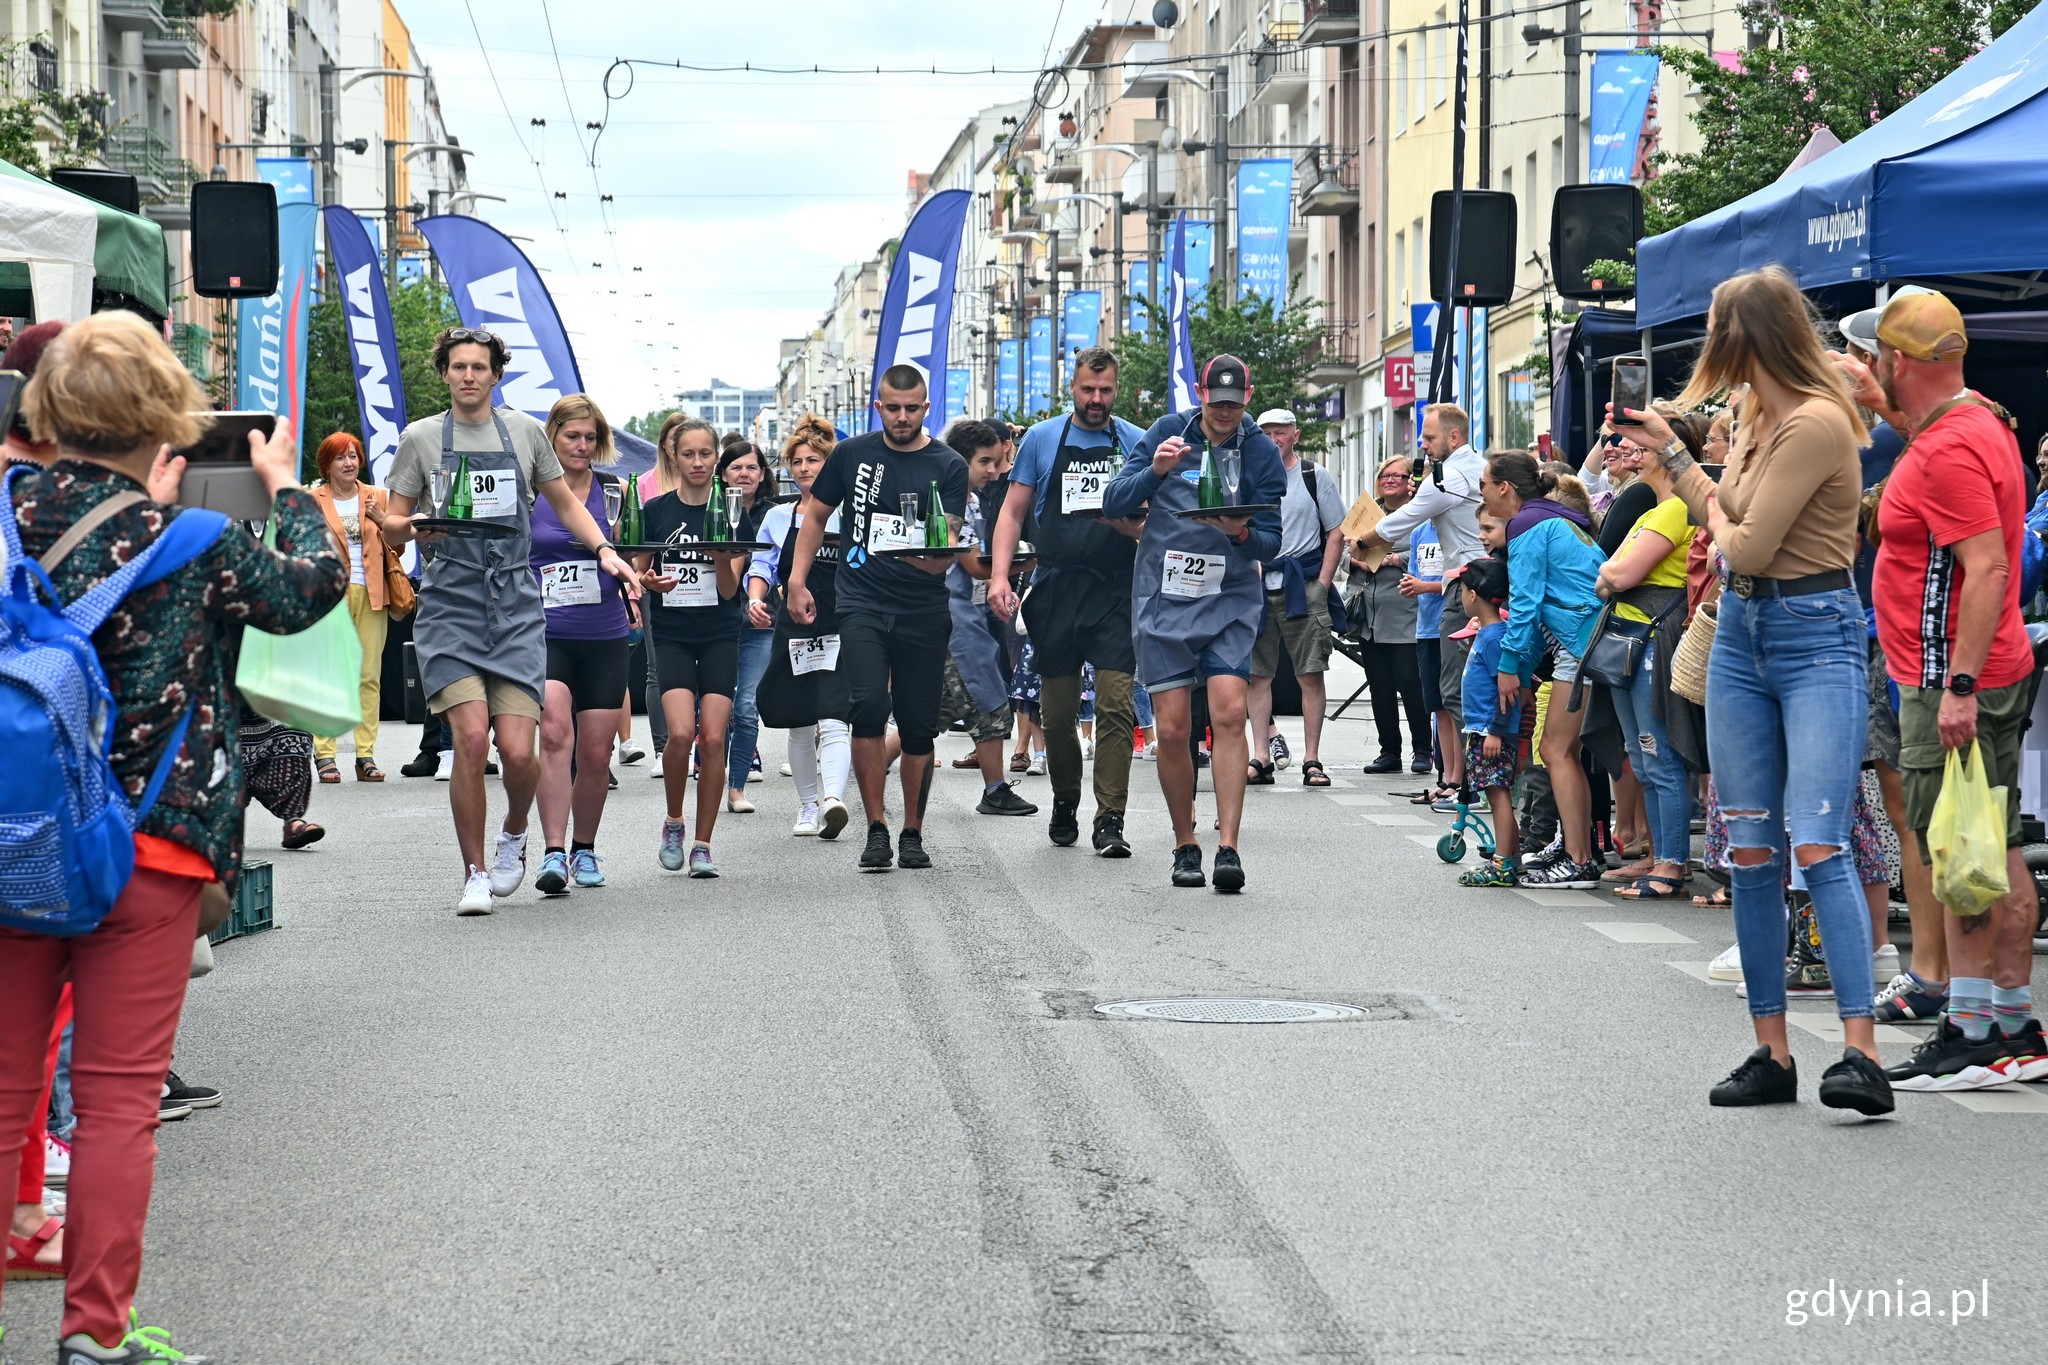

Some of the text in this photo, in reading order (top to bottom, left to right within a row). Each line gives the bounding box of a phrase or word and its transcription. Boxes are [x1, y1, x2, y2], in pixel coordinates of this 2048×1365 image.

[1807, 194, 1866, 253] www.gdynia.pl
[248, 264, 284, 412] dańs
[474, 475, 495, 493] 30
[867, 462, 885, 506] Fitness
[1080, 477, 1099, 493] 29
[852, 462, 873, 548] saturn
[1424, 546, 1436, 560] 14
[558, 565, 578, 583] 27
[1183, 556, 1206, 576] 22
[678, 567, 698, 584] 28
[806, 637, 824, 652] 34
